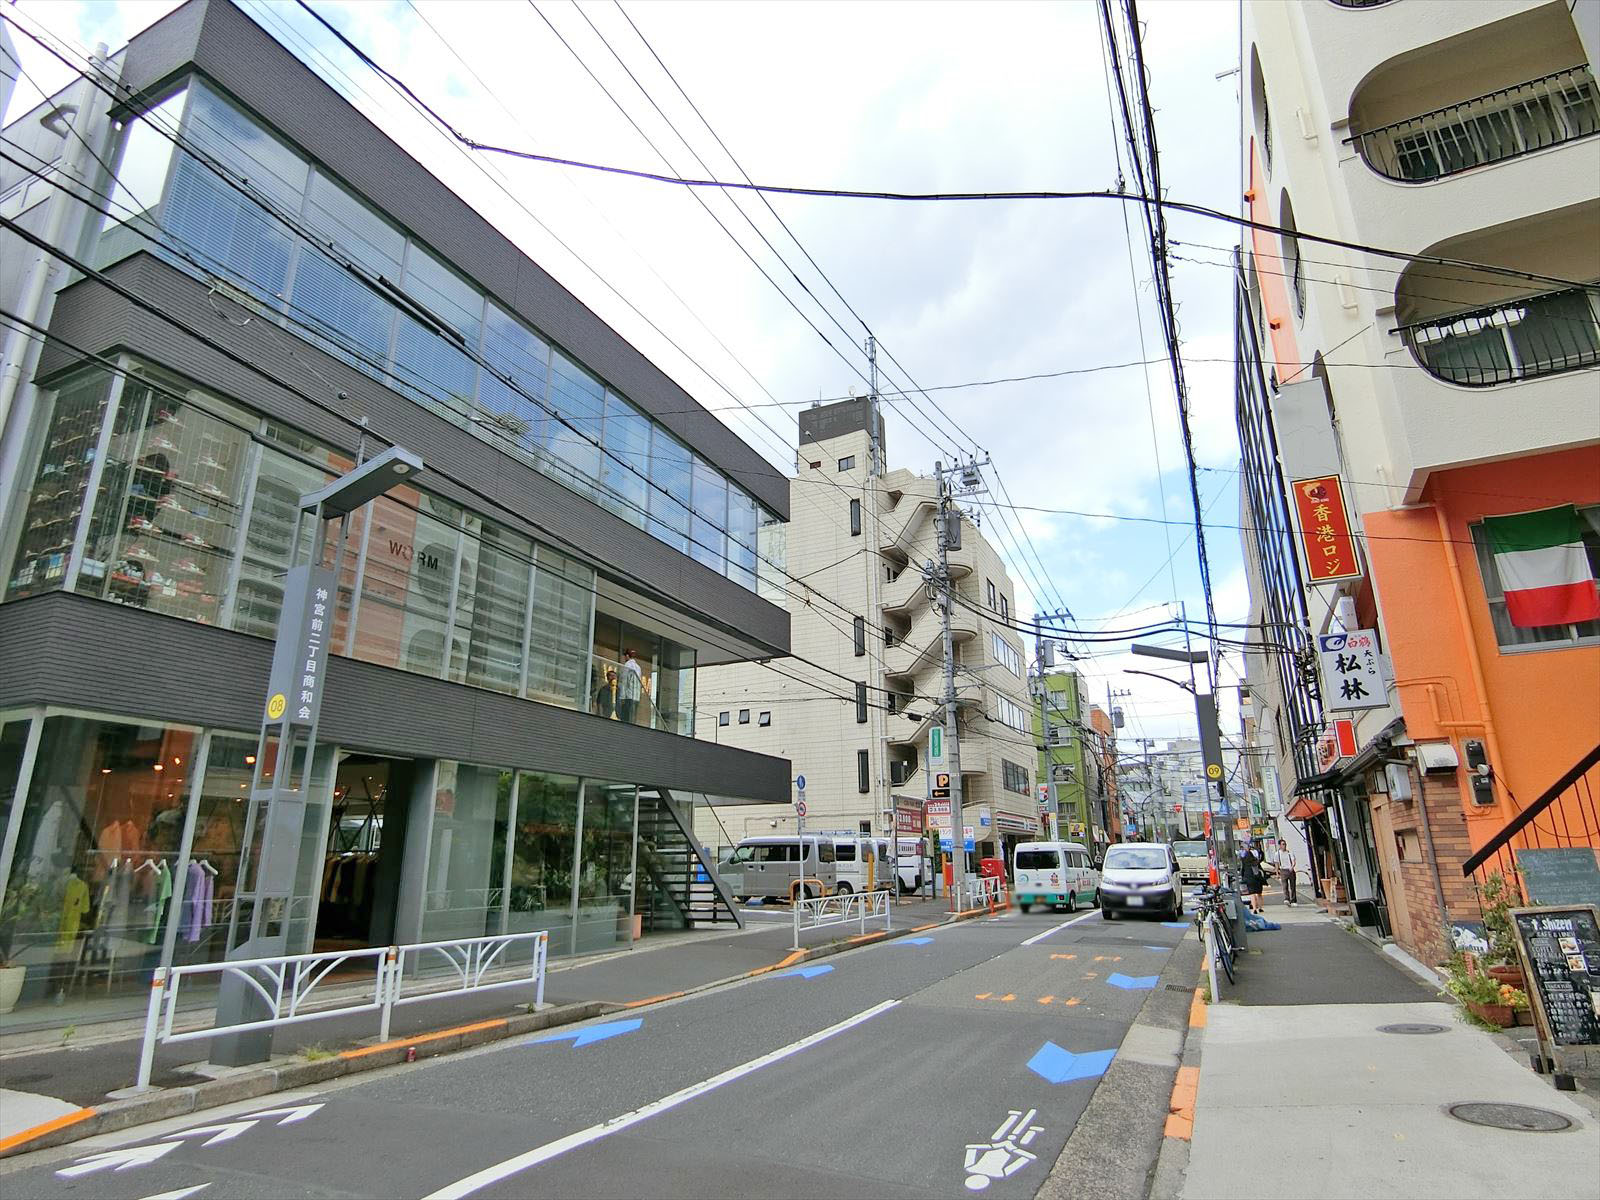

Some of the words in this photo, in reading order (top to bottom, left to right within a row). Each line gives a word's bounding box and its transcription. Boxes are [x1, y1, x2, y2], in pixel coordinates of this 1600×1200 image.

[1313, 504, 1341, 575] 香港ロジ
[389, 540, 439, 570] WORM
[298, 587, 329, 719] 神宮前二丁目商和会
[1334, 653, 1369, 700] 松林
[270, 699, 283, 713] 08
[938, 775, 948, 786] P
[1208, 767, 1220, 775] 09
